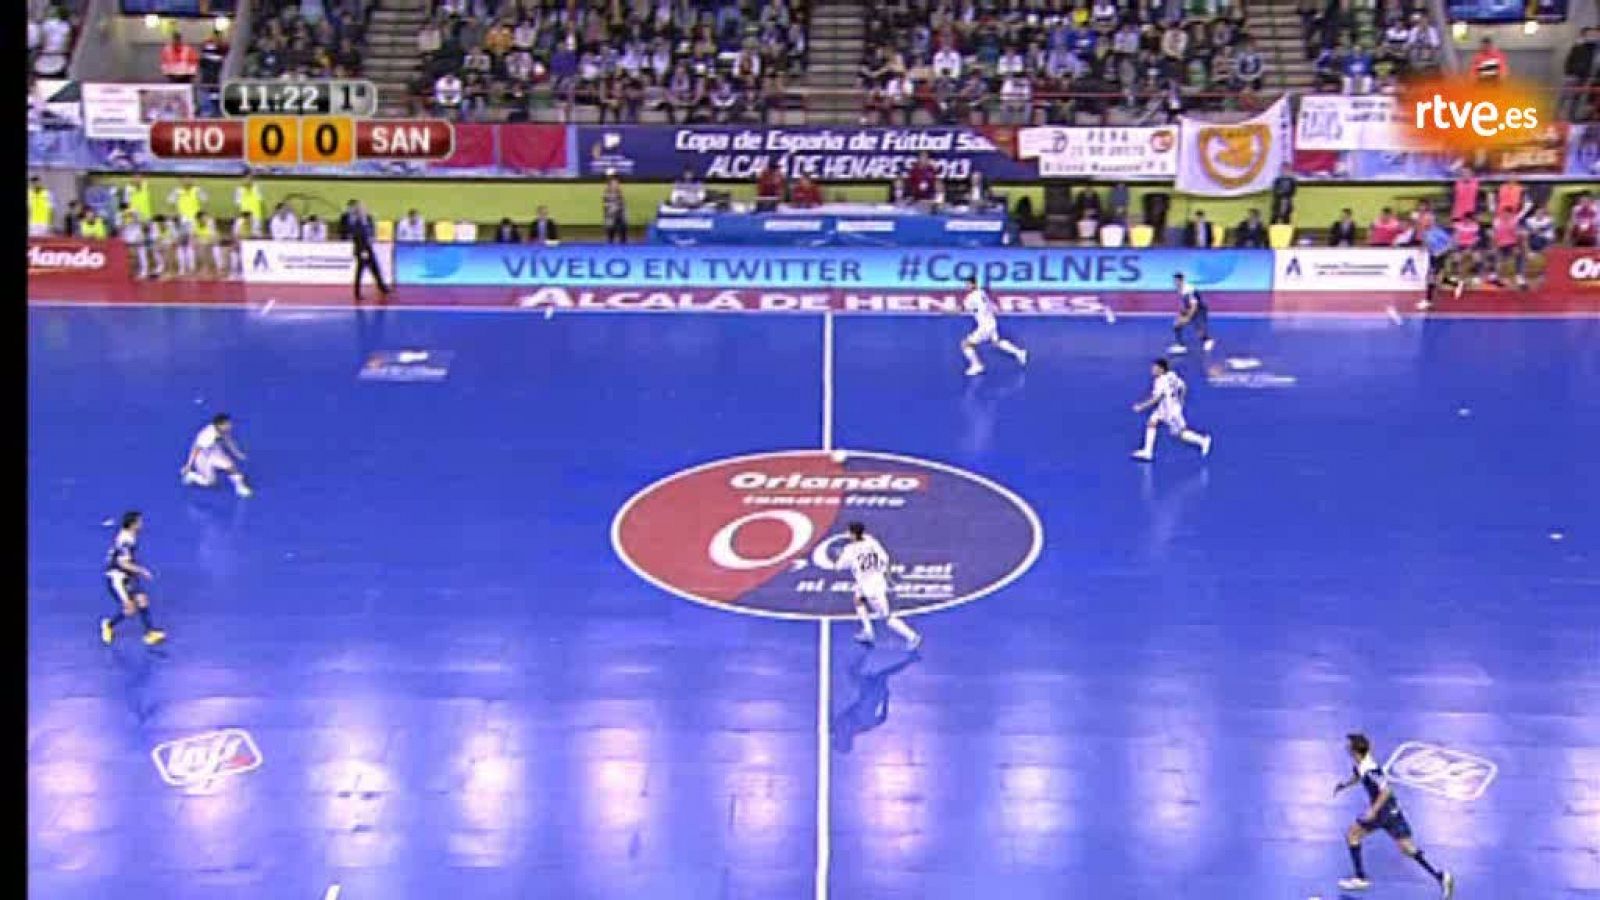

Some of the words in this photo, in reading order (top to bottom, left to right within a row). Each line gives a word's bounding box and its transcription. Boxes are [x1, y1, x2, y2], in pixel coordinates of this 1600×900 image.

[675, 130, 730, 153] Copa
[732, 131, 762, 150] de
[766, 130, 846, 153] España
[849, 131, 878, 151] de
[881, 130, 953, 151] Fútbol
[791, 154, 823, 179] DE
[822, 154, 917, 179] HENARES
[503, 251, 632, 281] VÍVELO
[644, 257, 690, 281] EN
[703, 256, 862, 283] TWITTER
[897, 253, 1142, 287] #CopaLNFS
[517, 286, 746, 310] ALCALÁ
[758, 294, 831, 311] DE
[843, 295, 1103, 312] HENRES
[730, 472, 920, 491] Orlando
